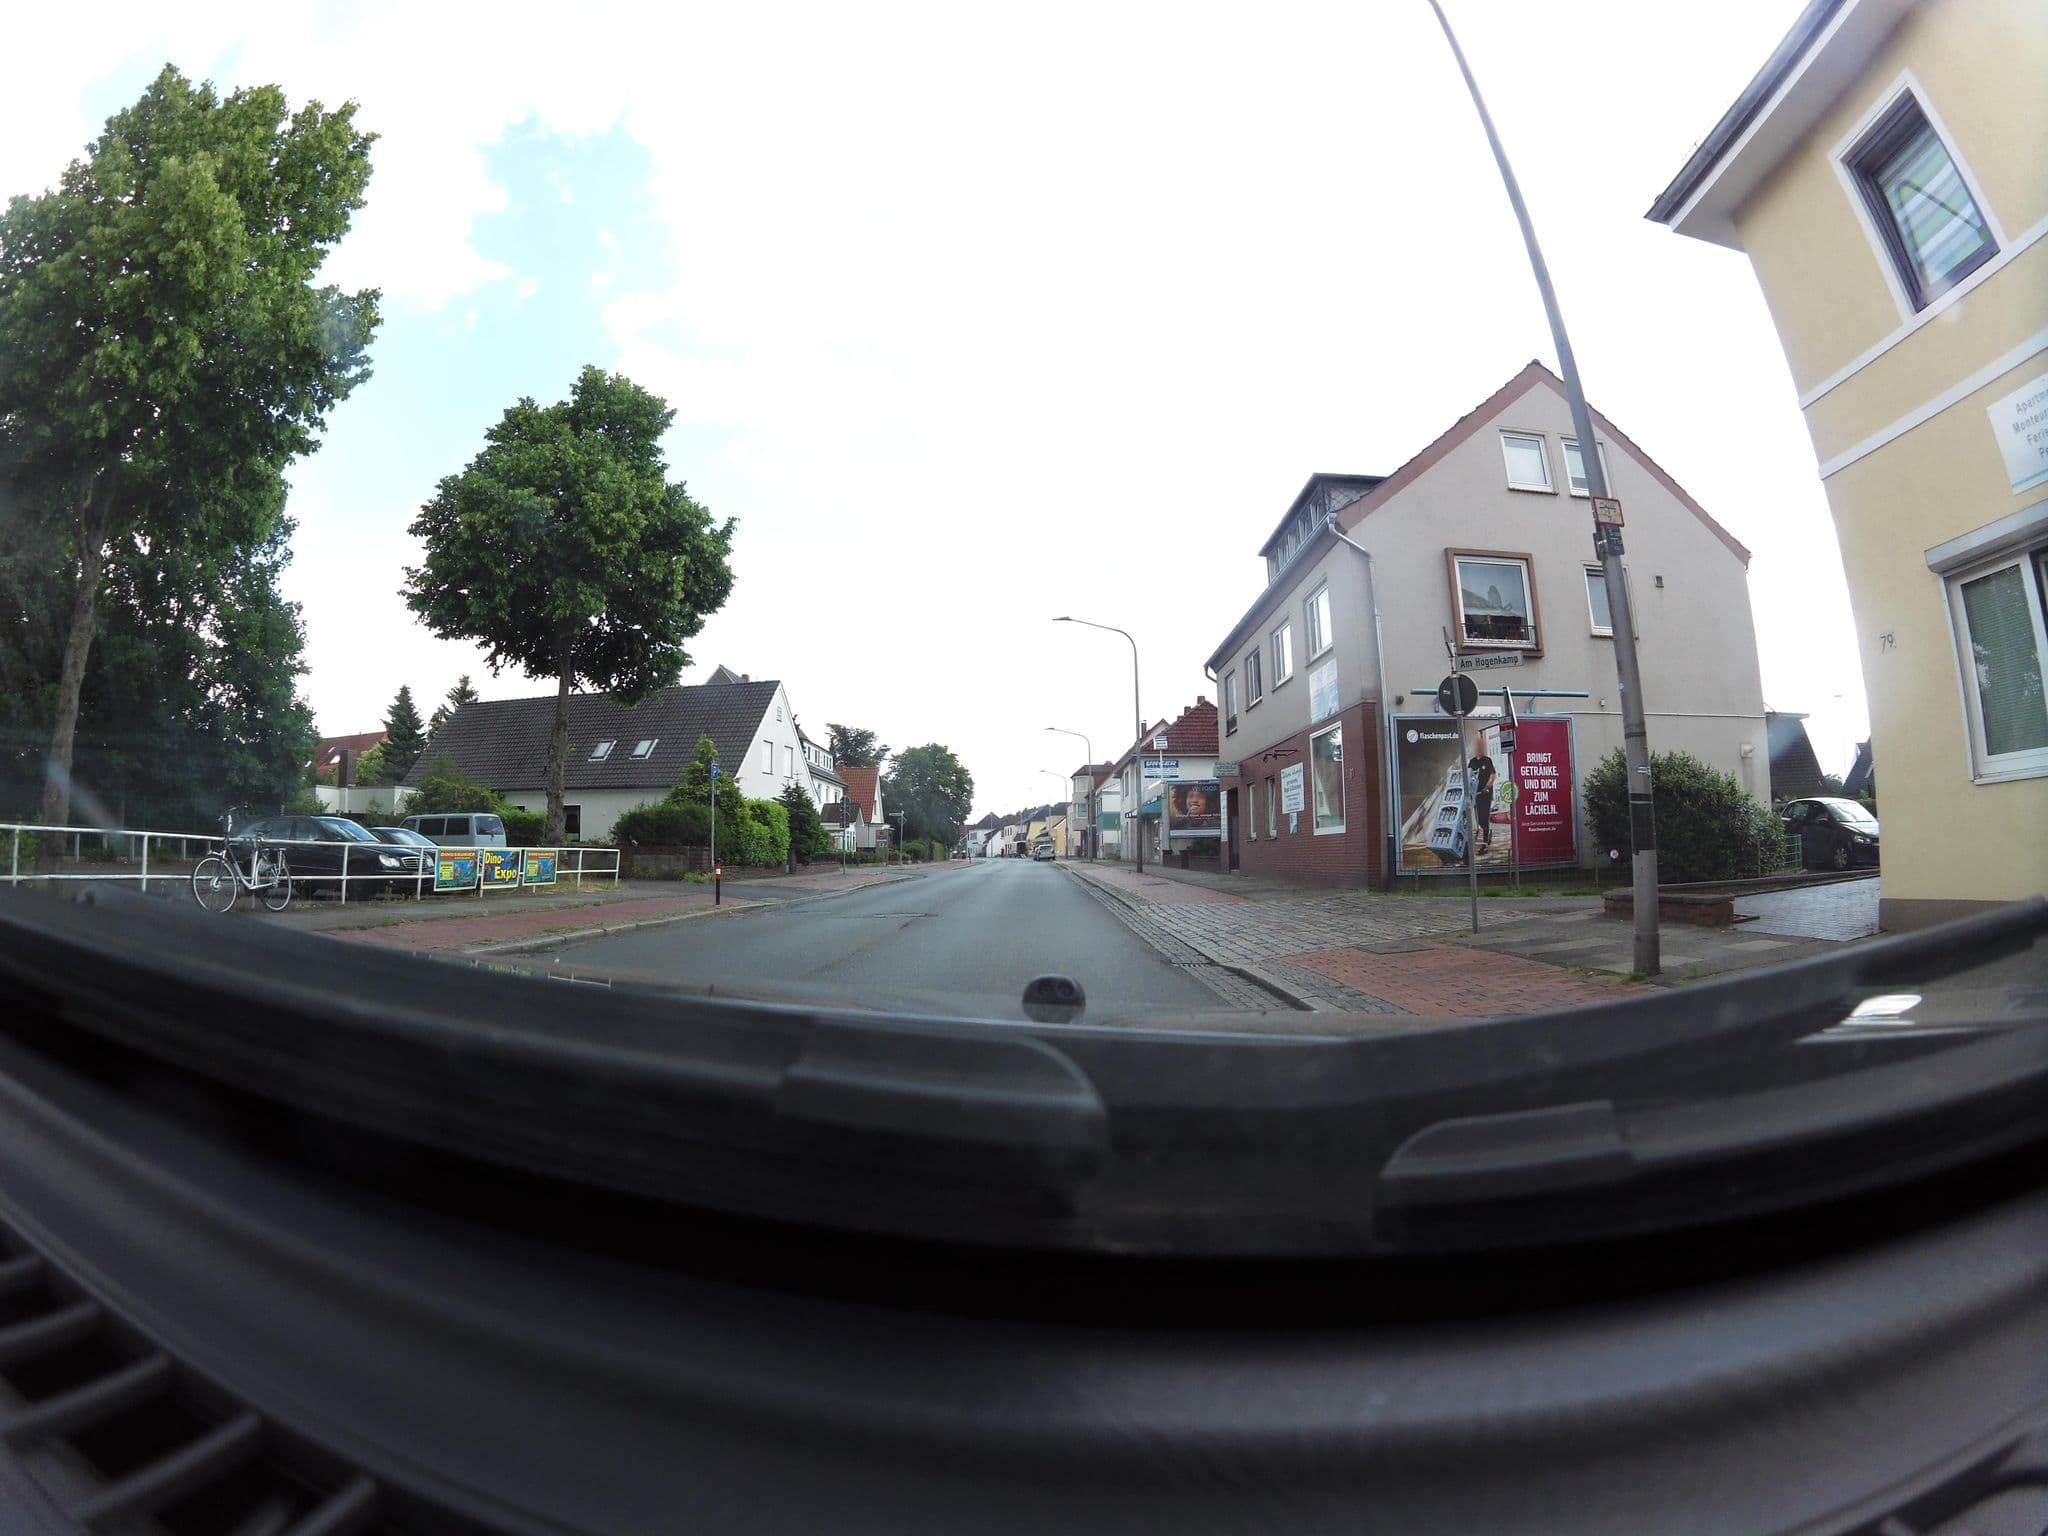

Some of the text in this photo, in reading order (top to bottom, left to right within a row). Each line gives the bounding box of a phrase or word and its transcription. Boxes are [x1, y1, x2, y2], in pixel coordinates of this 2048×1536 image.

[1879, 633, 1894, 654] 79
[1460, 659, 1472, 669] Am
[1526, 752, 1552, 763] BRINGT
[1520, 763, 1559, 776] GETRÄNKE.
[1524, 779, 1557, 789] UND DICH
[1533, 791, 1548, 802] ZUM
[1525, 802, 1558, 815] LÄCHELN.
[485, 852, 504, 864] Dino-
[495, 866, 517, 881] Expo
